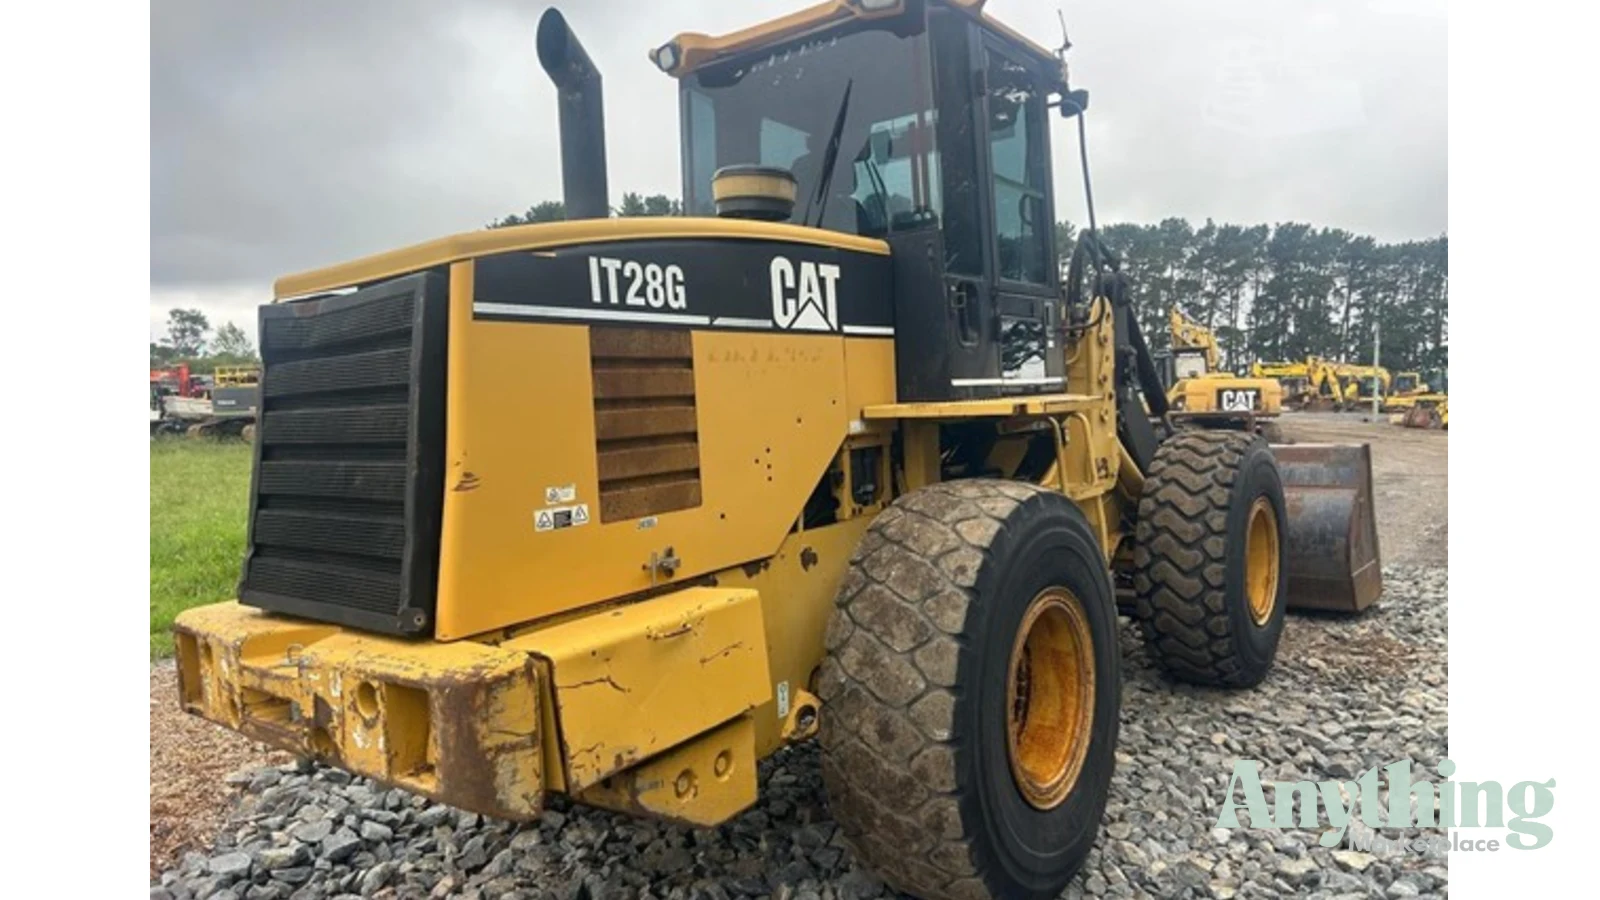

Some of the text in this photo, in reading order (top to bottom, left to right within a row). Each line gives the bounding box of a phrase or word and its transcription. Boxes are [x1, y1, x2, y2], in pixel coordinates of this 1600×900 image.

[589, 256, 687, 309] IT28G
[770, 256, 840, 331] CAT
[1222, 390, 1257, 411] CAT
